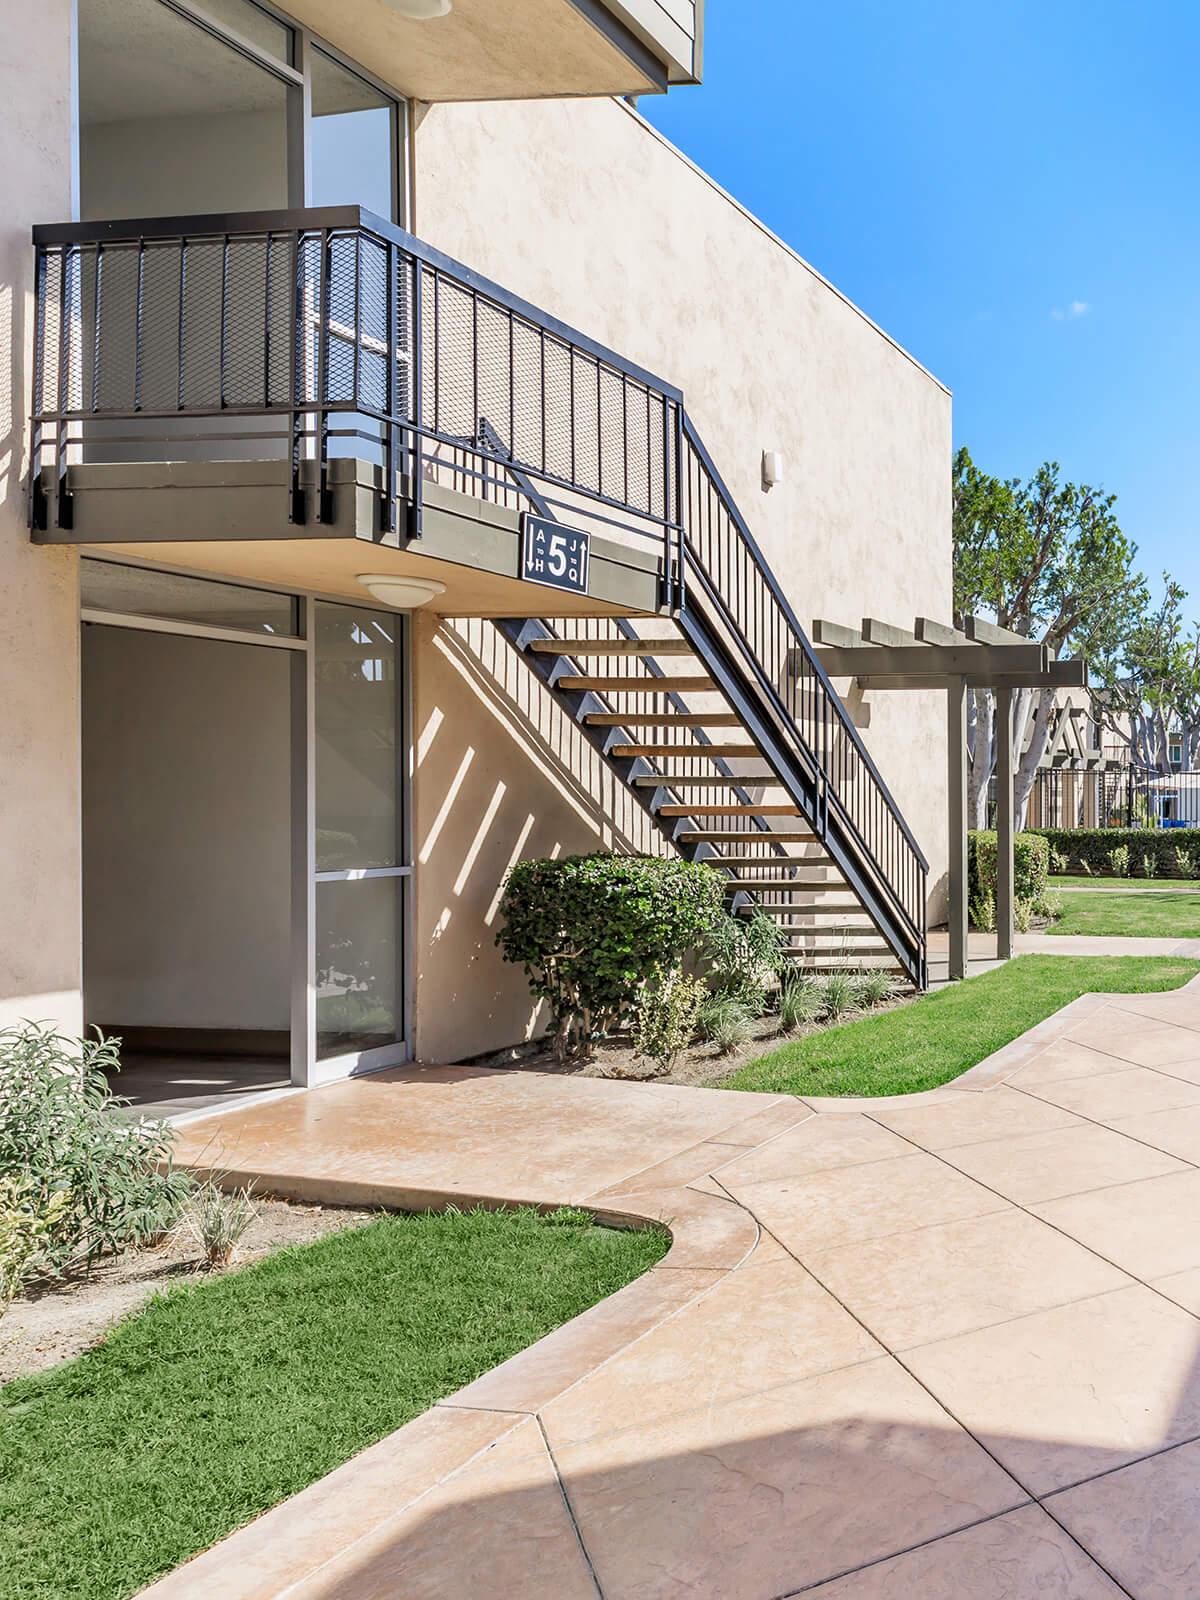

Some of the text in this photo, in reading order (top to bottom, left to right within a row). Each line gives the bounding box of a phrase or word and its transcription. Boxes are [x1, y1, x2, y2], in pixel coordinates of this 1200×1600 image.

[536, 529, 546, 543] A
[570, 540, 577, 552] J
[548, 535, 567, 577] 5
[535, 559, 544, 573] H
[568, 568, 577, 582] Q
